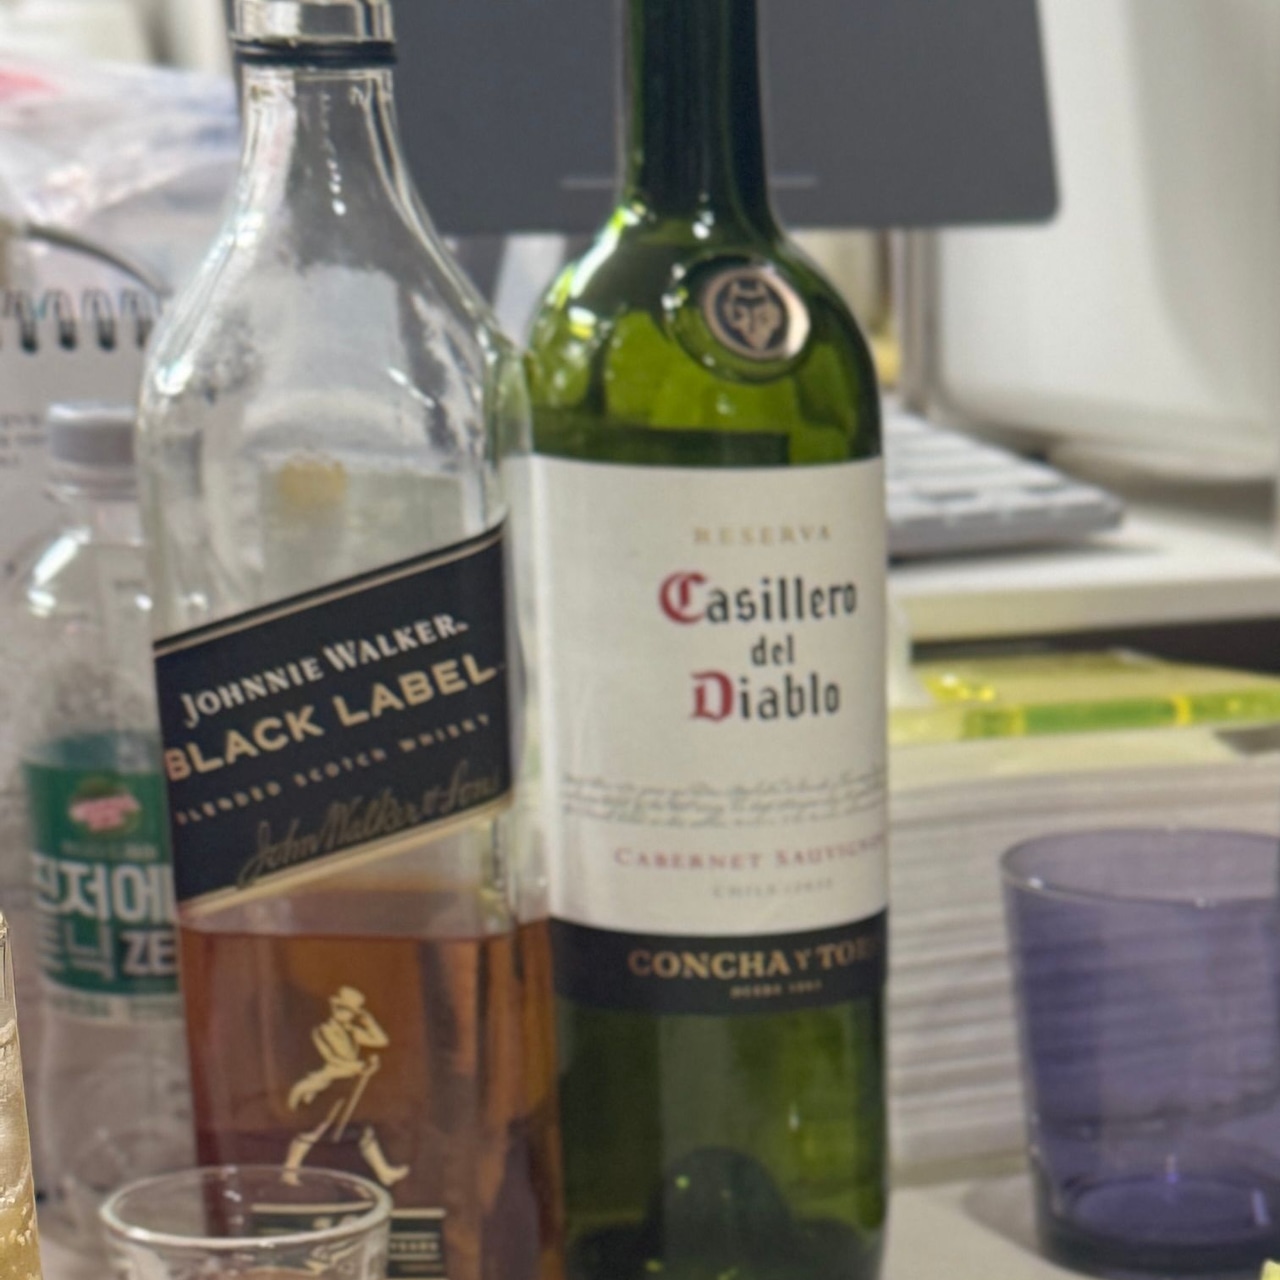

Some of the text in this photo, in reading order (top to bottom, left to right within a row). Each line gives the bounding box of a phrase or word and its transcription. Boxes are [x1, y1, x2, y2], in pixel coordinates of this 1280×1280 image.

[693, 525, 831, 547] RESERVA
[658, 570, 858, 626] Casillero
[749, 634, 796, 667] del
[163, 653, 497, 782] BLACK LABEL
[181, 656, 325, 729] JOHNNIE
[689, 669, 841, 723] Diablo
[292, 747, 388, 788] SCOTCH
[398, 713, 489, 752] WHISKY
[613, 846, 762, 871] CABERNET
[31, 852, 176, 925] 진저에
[119, 928, 177, 978] ZE
[627, 949, 791, 980] CONCHA
[813, 936, 878, 970] TOR
